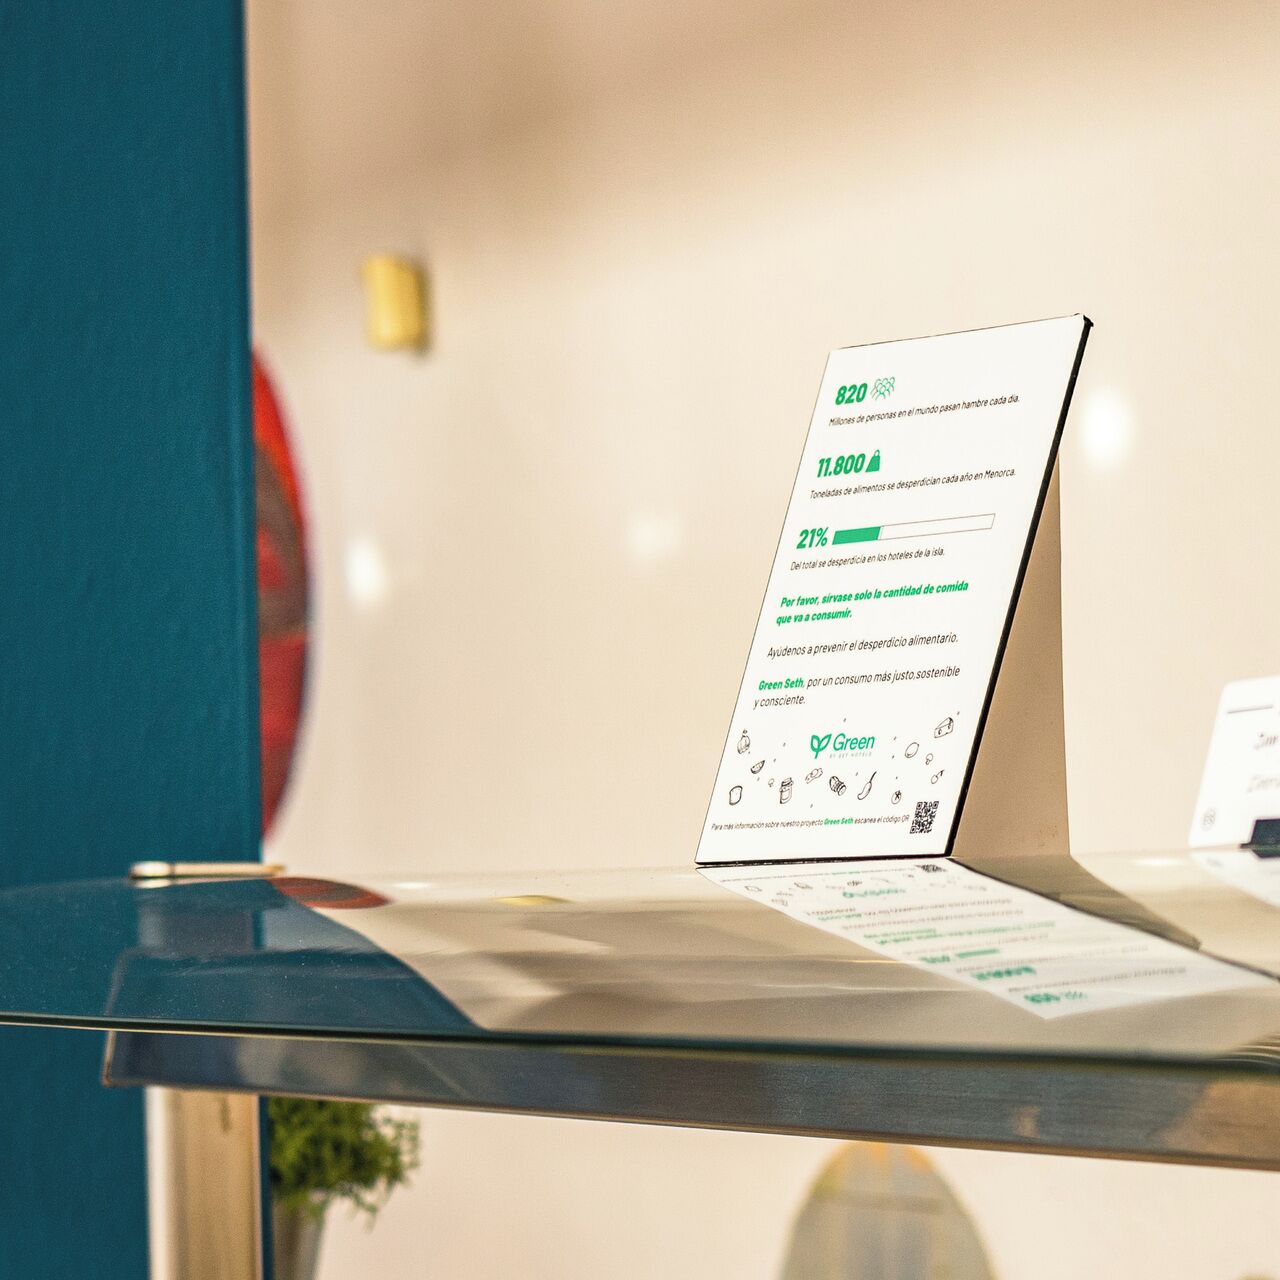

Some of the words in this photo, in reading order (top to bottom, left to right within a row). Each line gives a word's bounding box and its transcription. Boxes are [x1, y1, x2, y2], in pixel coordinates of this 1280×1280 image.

[835, 383, 868, 405] 820
[829, 417, 855, 426] Millones
[856, 415, 865, 423] de
[865, 412, 897, 423] personas
[897, 410, 907, 418] en
[907, 408, 914, 417] el
[915, 405, 939, 415] mundo
[939, 403, 961, 414] pasan
[961, 399, 988, 409] hambre
[989, 396, 1007, 406] cada
[817, 453, 866, 477] 11.800
[811, 489, 842, 499] Toneladas
[843, 488, 852, 496] de
[853, 484, 886, 494] alimentos
[896, 477, 941, 489] desperdician
[941, 475, 959, 484] cada
[959, 472, 973, 482] año
[974, 472, 983, 480] en
[984, 469, 1016, 479] Menorca.
[797, 528, 828, 549] 21%
[790, 561, 802, 571] Del
[802, 560, 818, 569] total
[818, 560, 827, 568] se
[827, 556, 866, 567] desperdicia
[867, 555, 876, 563] en
[877, 554, 887, 562] los
[888, 551, 913, 560] hoteles
[914, 549, 923, 558] de
[924, 548, 931, 557] la
[932, 547, 945, 556] isla.
[781, 597, 795, 607] Por
[797, 596, 819, 606] favor,
[854, 590, 872, 601] solo
[873, 589, 882, 599] la
[883, 585, 922, 598] cantidad
[923, 584, 934, 594] de
[936, 581, 969, 593] comida
[776, 616, 792, 626] que
[794, 614, 804, 622] va
[804, 614, 810, 622] a
[768, 646, 806, 660] Ayúdenos
[807, 646, 813, 655] a
[813, 641, 848, 656] prevenir
[849, 640, 857, 651] el
[858, 637, 907, 651] desperdicio
[908, 632, 959, 646] alimentario.
[758, 680, 783, 691] Green
[807, 678, 822, 689] por
[822, 677, 833, 686] un
[834, 675, 872, 685] consumo
[874, 673, 892, 682] más
[753, 700, 759, 710] y
[760, 695, 806, 707] consciente.
[833, 732, 875, 751] Green
